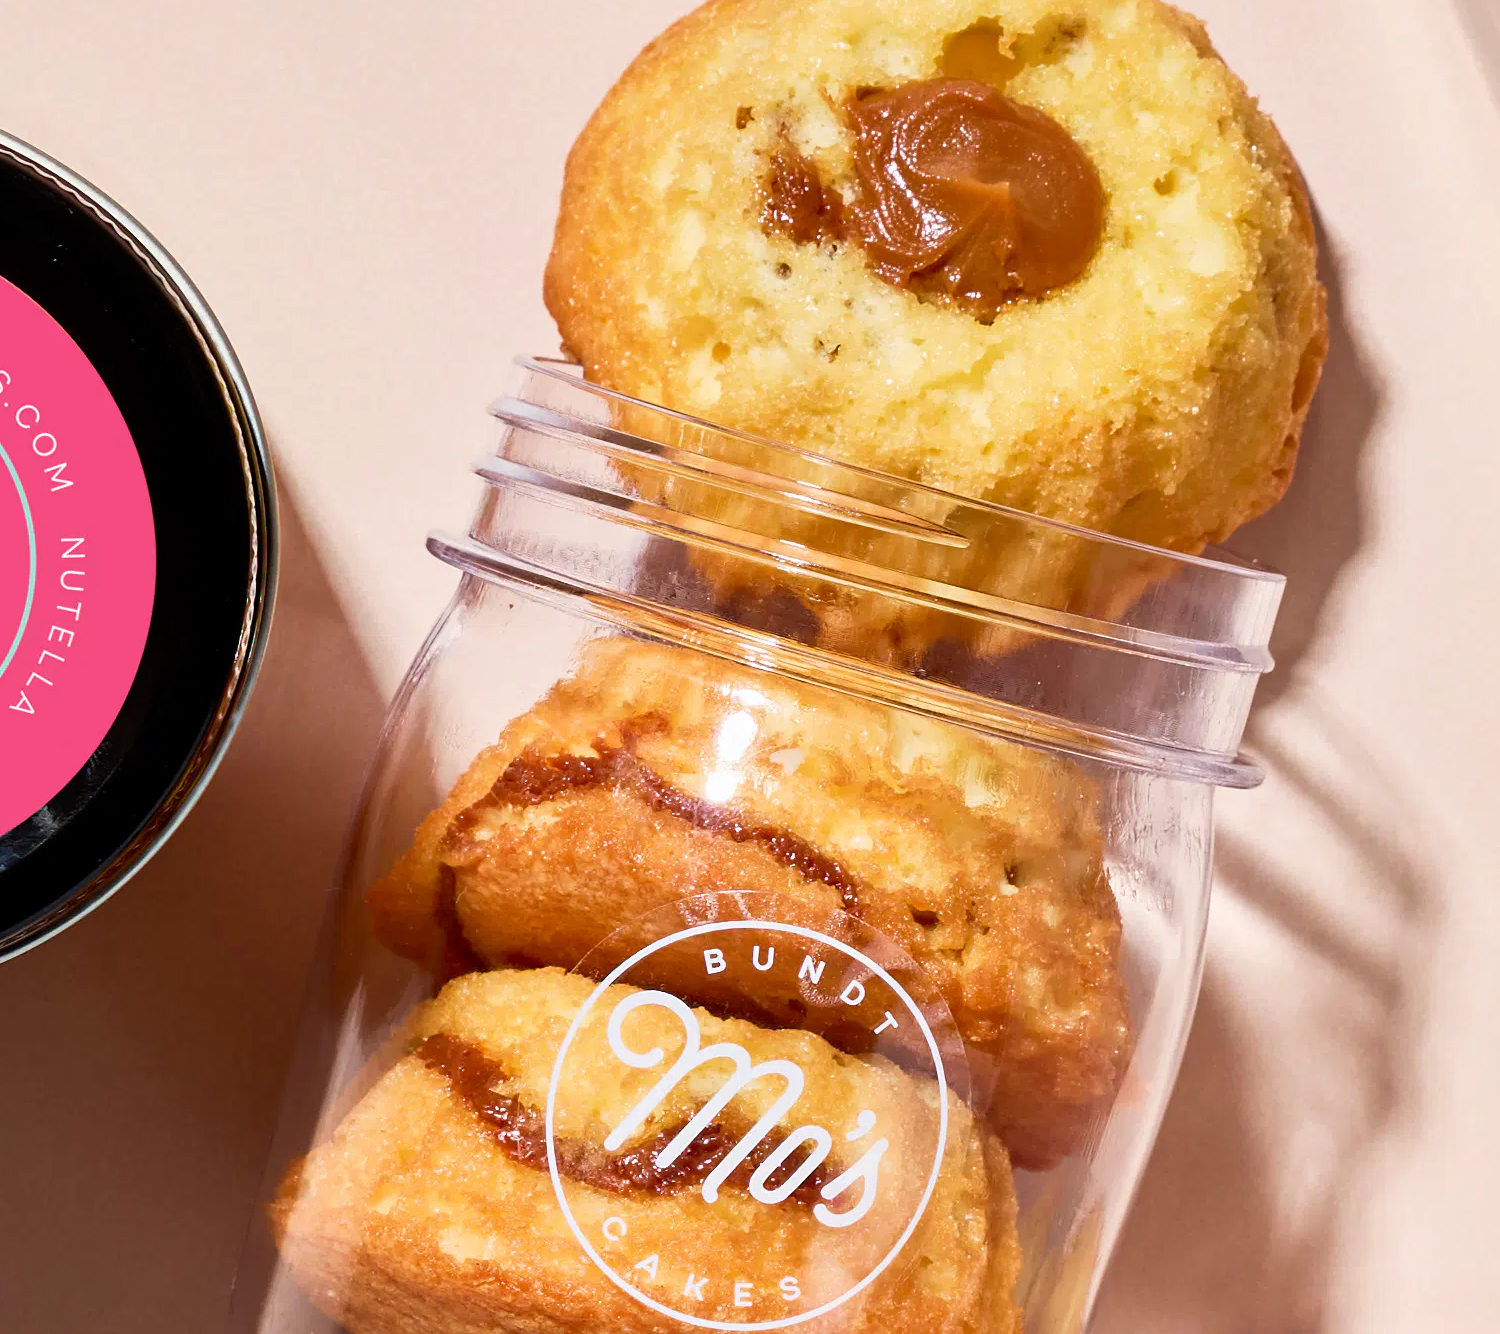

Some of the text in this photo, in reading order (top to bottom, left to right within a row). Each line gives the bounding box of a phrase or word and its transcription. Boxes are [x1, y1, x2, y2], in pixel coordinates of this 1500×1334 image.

[9, 538, 85, 714] NUTELLA
[703, 945, 899, 1036] BUNDT
[603, 989, 889, 1228] Mo's
[602, 1216, 802, 1307] CAKES
